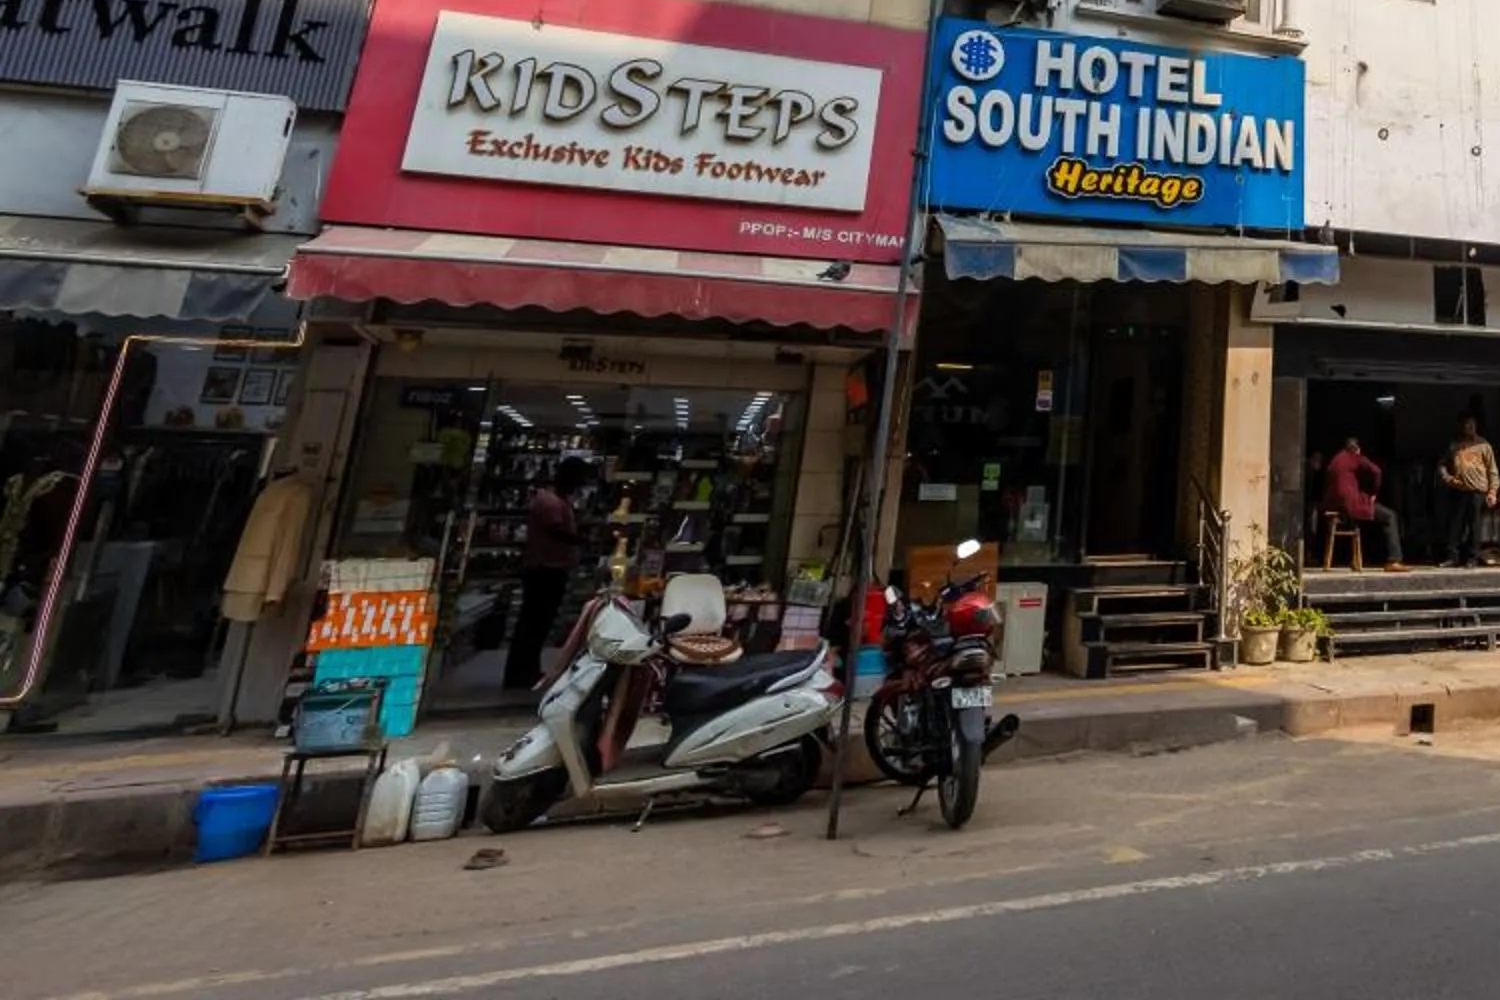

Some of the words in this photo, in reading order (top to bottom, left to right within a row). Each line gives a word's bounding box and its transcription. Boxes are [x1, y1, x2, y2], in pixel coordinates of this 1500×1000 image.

[1035, 39, 1222, 107] HOTEL
[944, 86, 1121, 158] SOUTH
[1136, 107, 1293, 172] INDIAN
[465, 130, 609, 169] Exclusive
[623, 145, 684, 176] Kids
[695, 152, 826, 190] Footwear
[1050, 157, 1202, 206] Heritage
[803, 227, 832, 241] M/S
